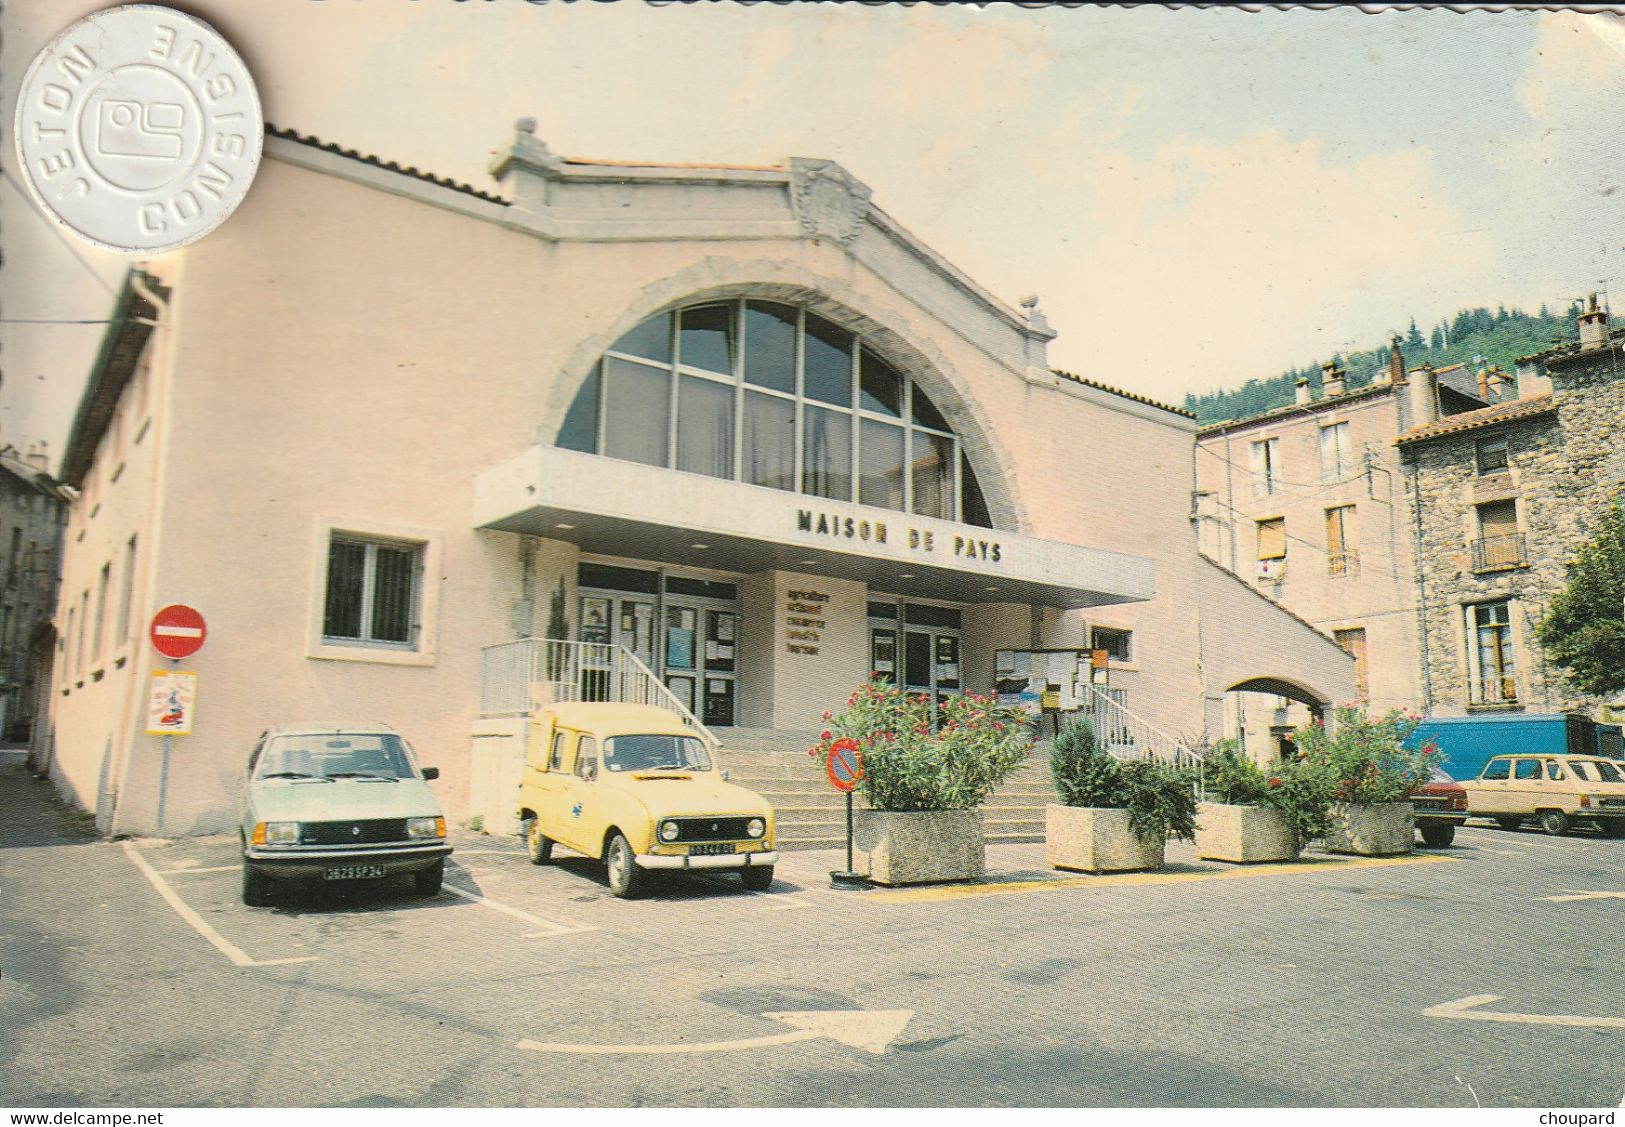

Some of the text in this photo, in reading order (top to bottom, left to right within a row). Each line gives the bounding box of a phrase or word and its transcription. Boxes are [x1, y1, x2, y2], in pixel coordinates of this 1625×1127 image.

[33, 44, 97, 199] JETON
[138, 24, 245, 236] CONSIGNE
[797, 508, 1001, 562] MAISON DE PAYS
